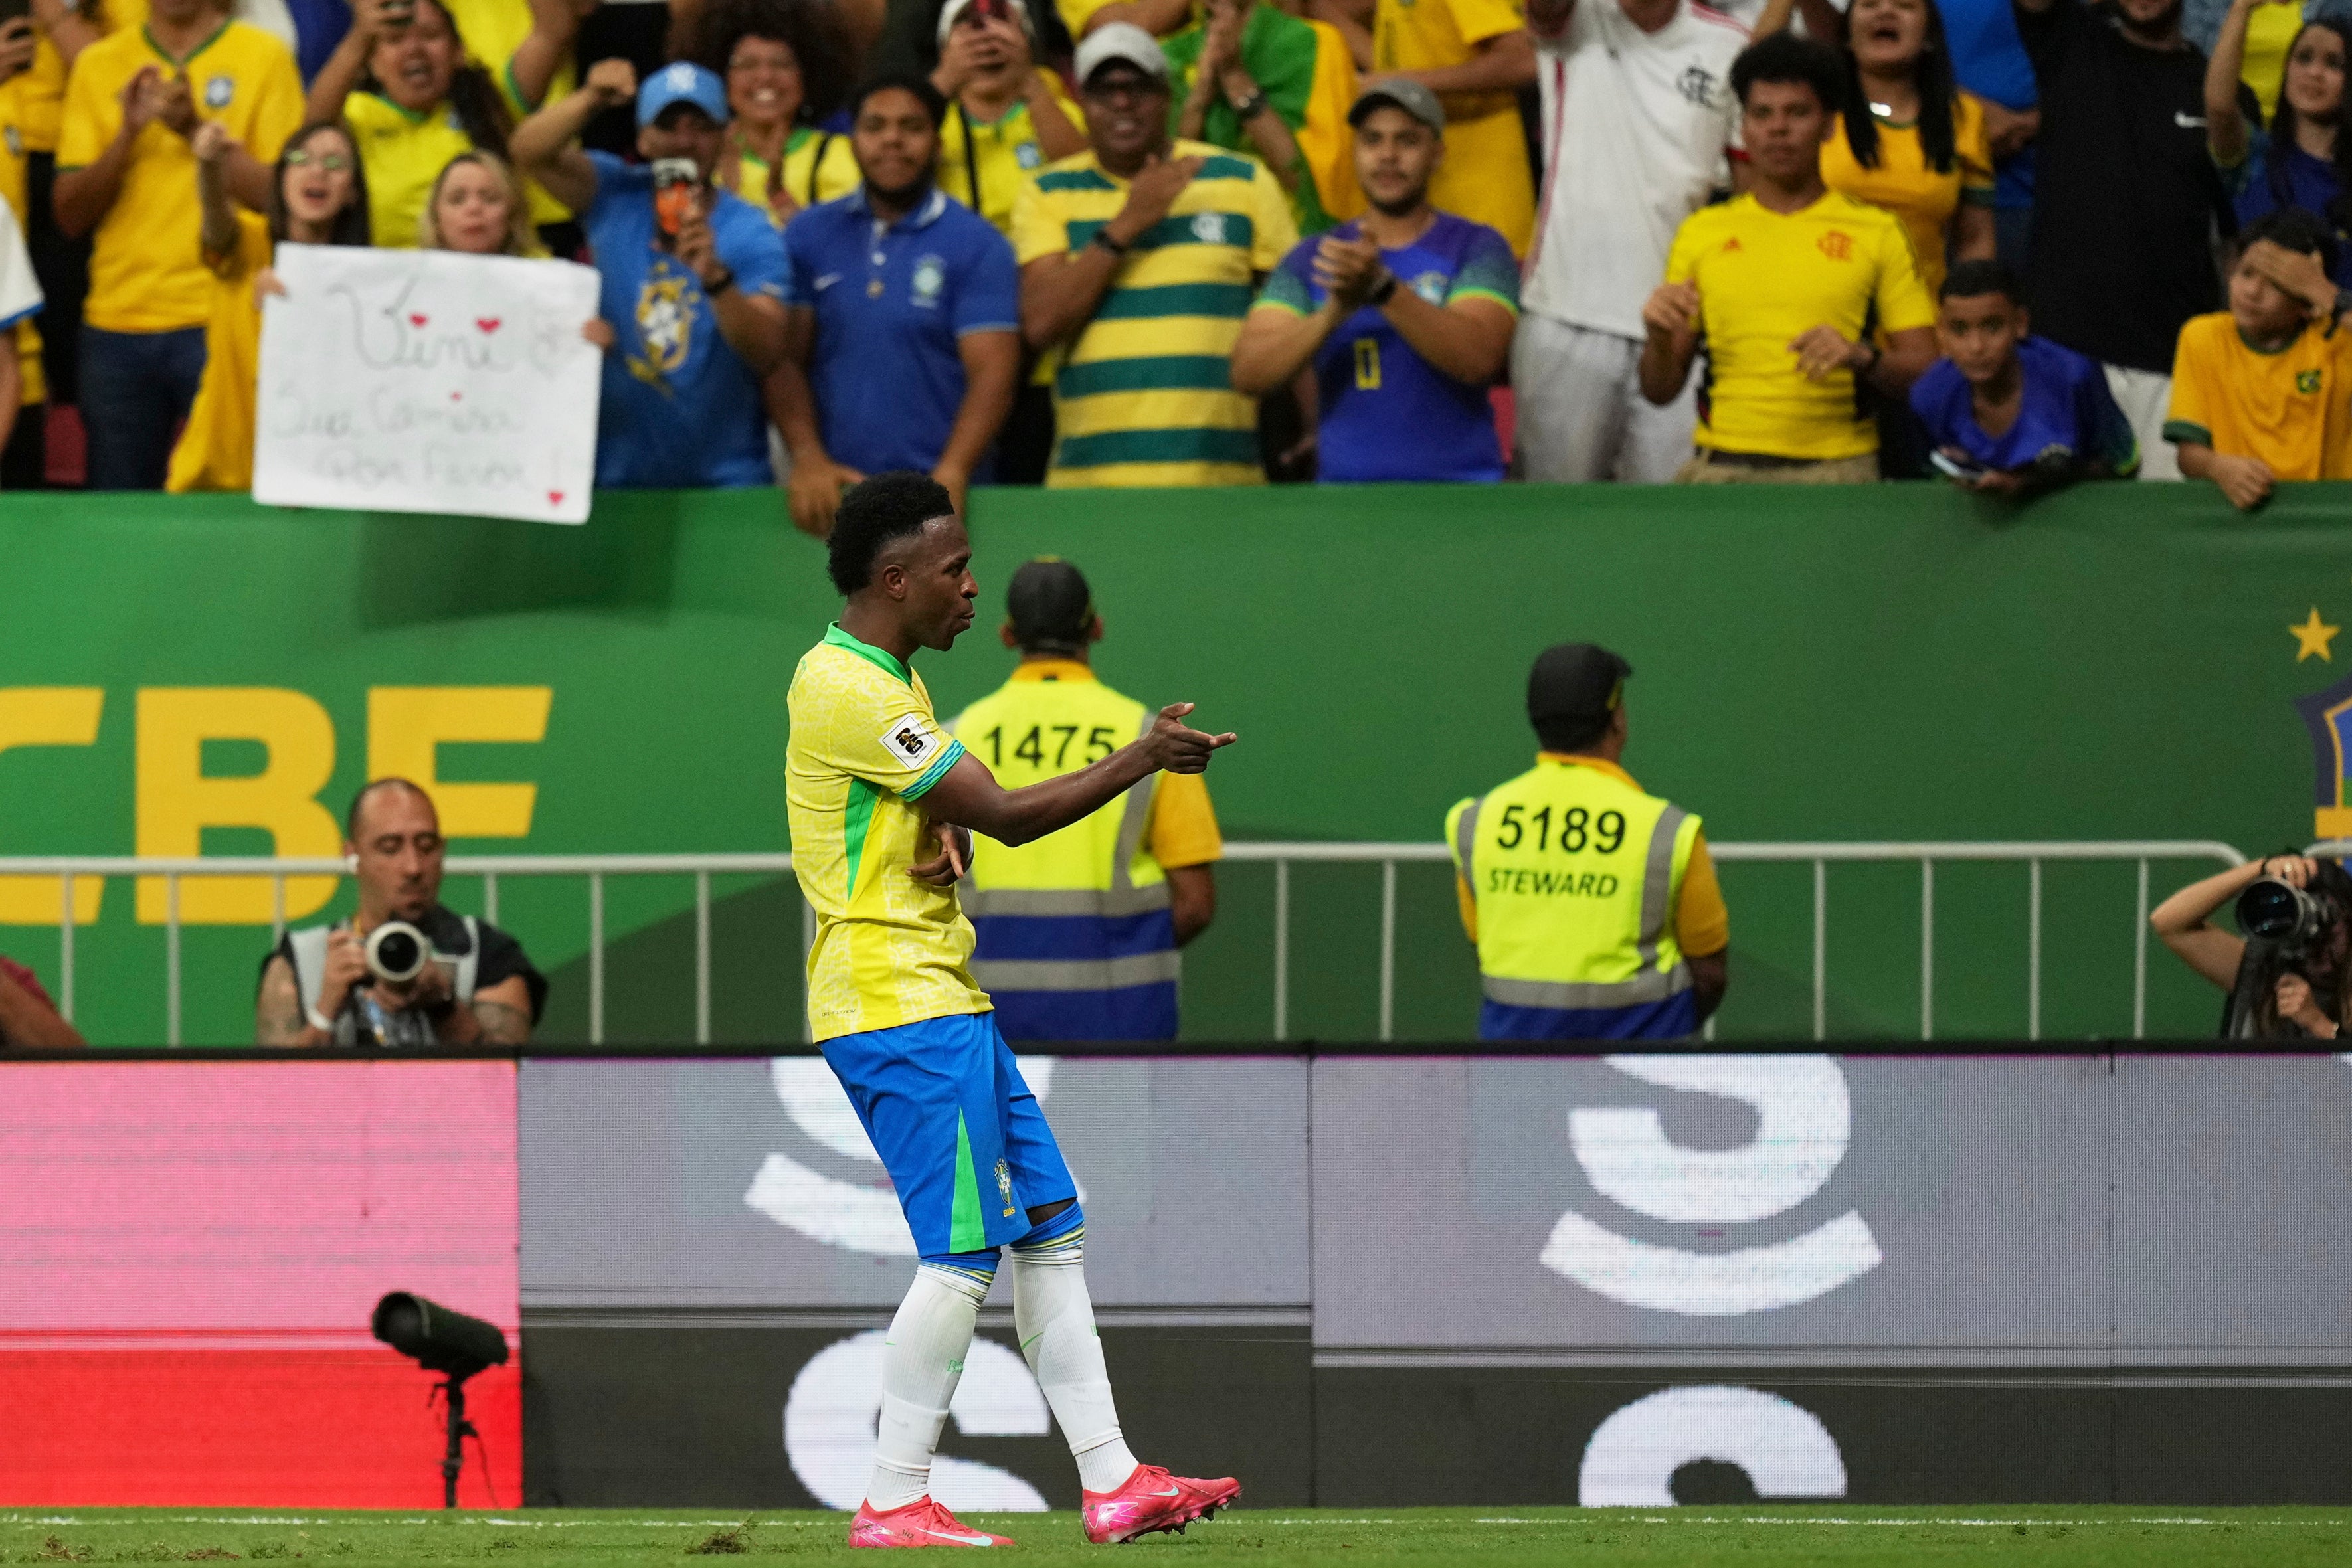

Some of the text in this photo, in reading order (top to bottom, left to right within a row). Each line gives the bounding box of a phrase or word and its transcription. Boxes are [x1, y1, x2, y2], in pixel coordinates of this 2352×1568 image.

[983, 725, 1115, 768] 1475
[1496, 804, 1627, 855] 5189
[1488, 867, 1619, 898] STEWARD
